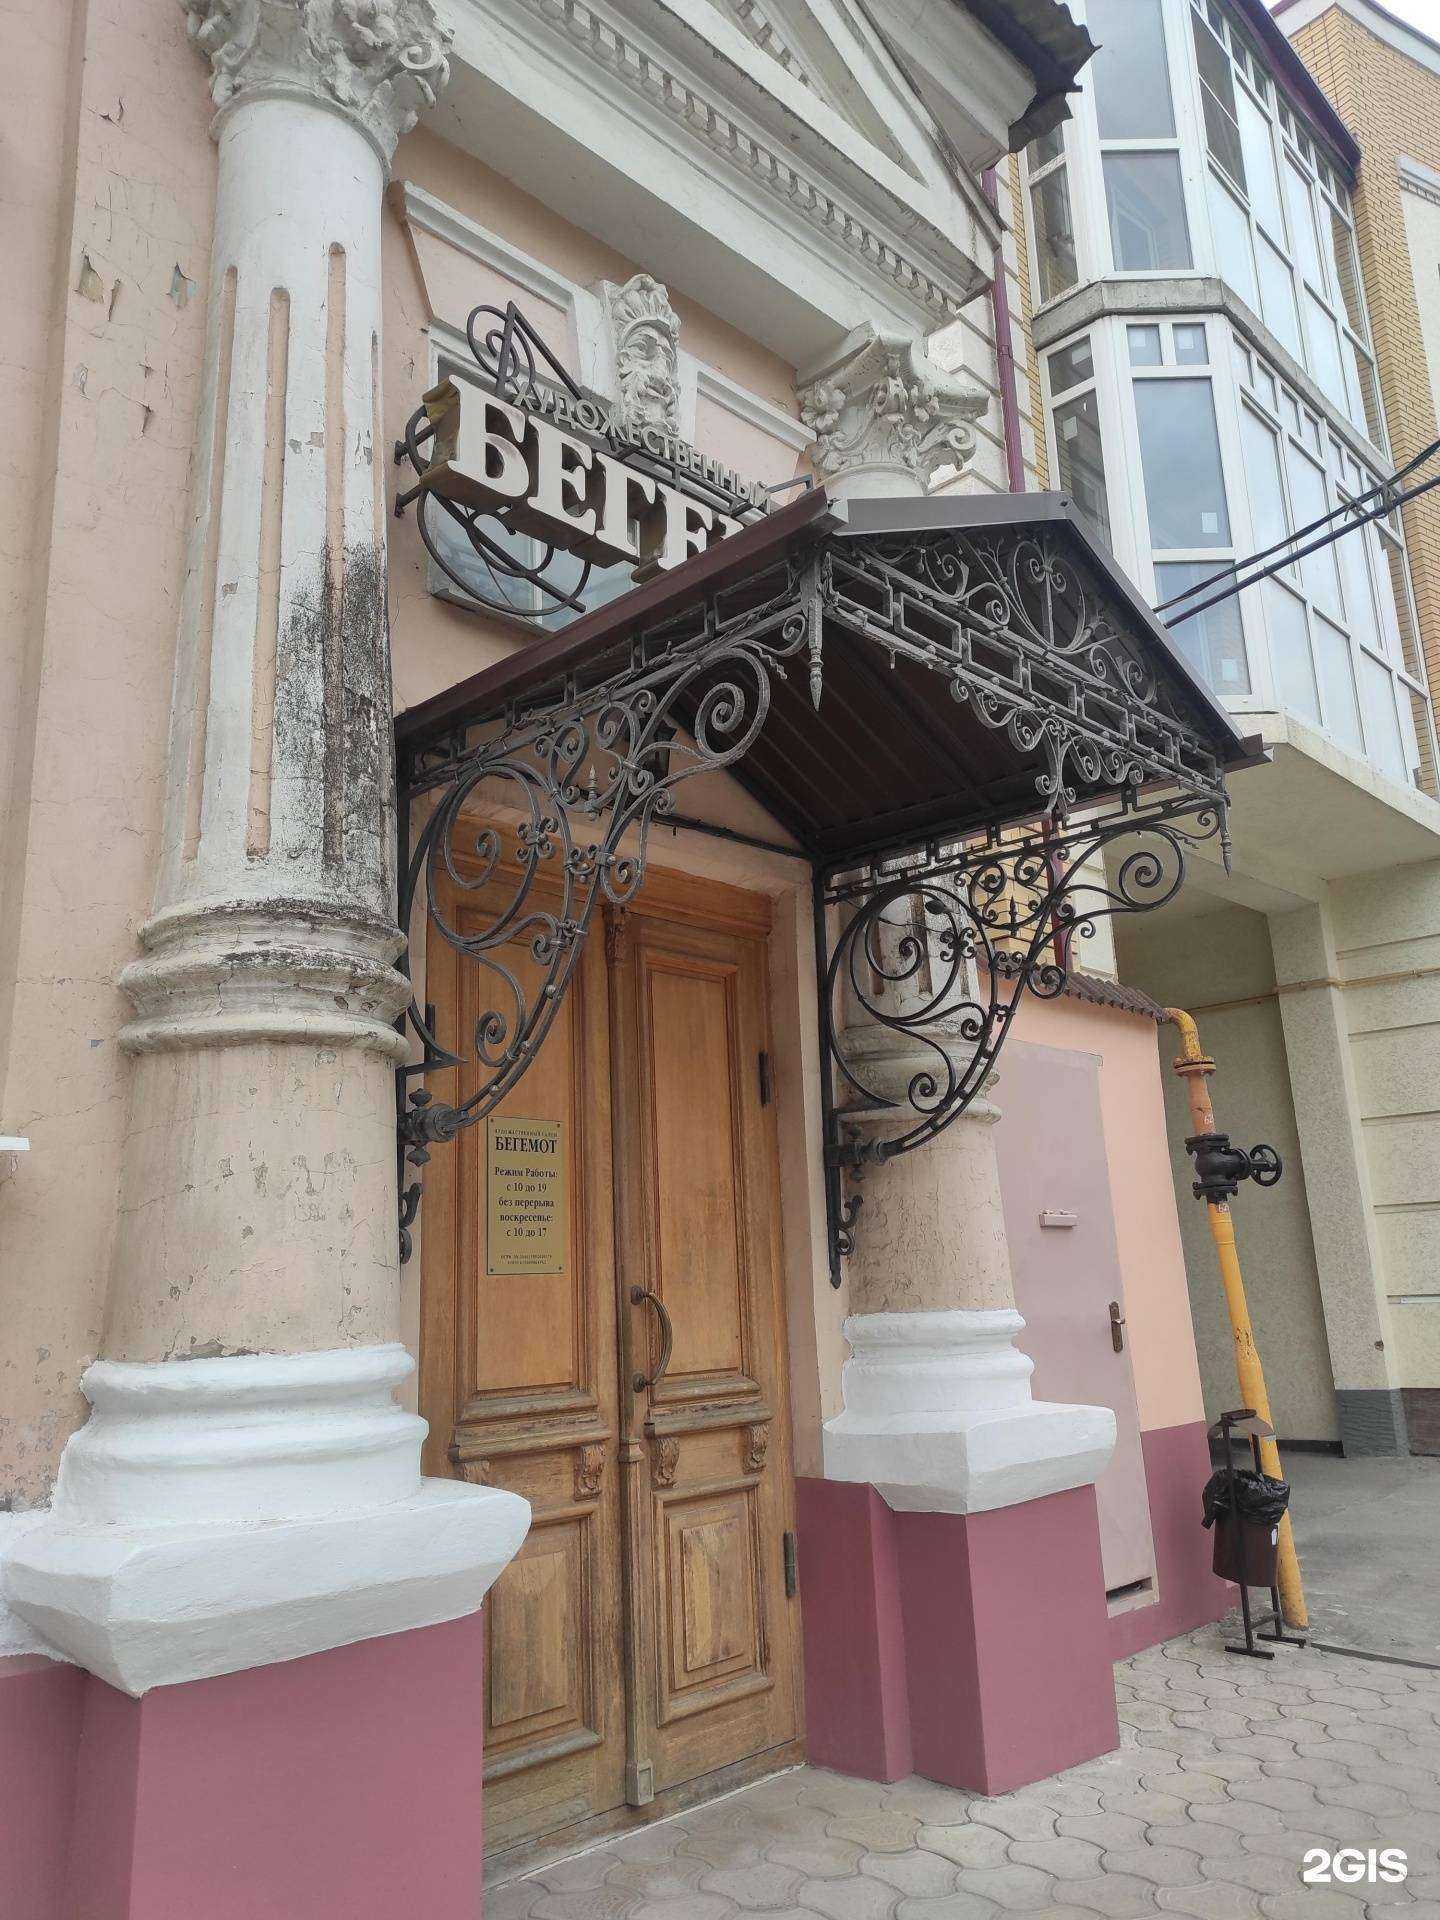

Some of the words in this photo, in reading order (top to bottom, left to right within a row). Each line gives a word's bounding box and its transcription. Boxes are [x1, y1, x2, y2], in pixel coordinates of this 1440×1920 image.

[448, 374, 744, 571] БЕГЕ
[495, 1137, 557, 1154] БЕГЕМОТ
[495, 1167, 523, 1177] Режим
[525, 1168, 558, 1178] Работы:
[514, 1182, 523, 1192] 10
[525, 1185, 535, 1193] до
[538, 1183, 547, 1193] 19
[498, 1197, 513, 1207] без
[515, 1199, 554, 1209] перерыва
[514, 1227, 523, 1237] 10
[525, 1230, 535, 1238] до
[538, 1228, 547, 1237] 17
